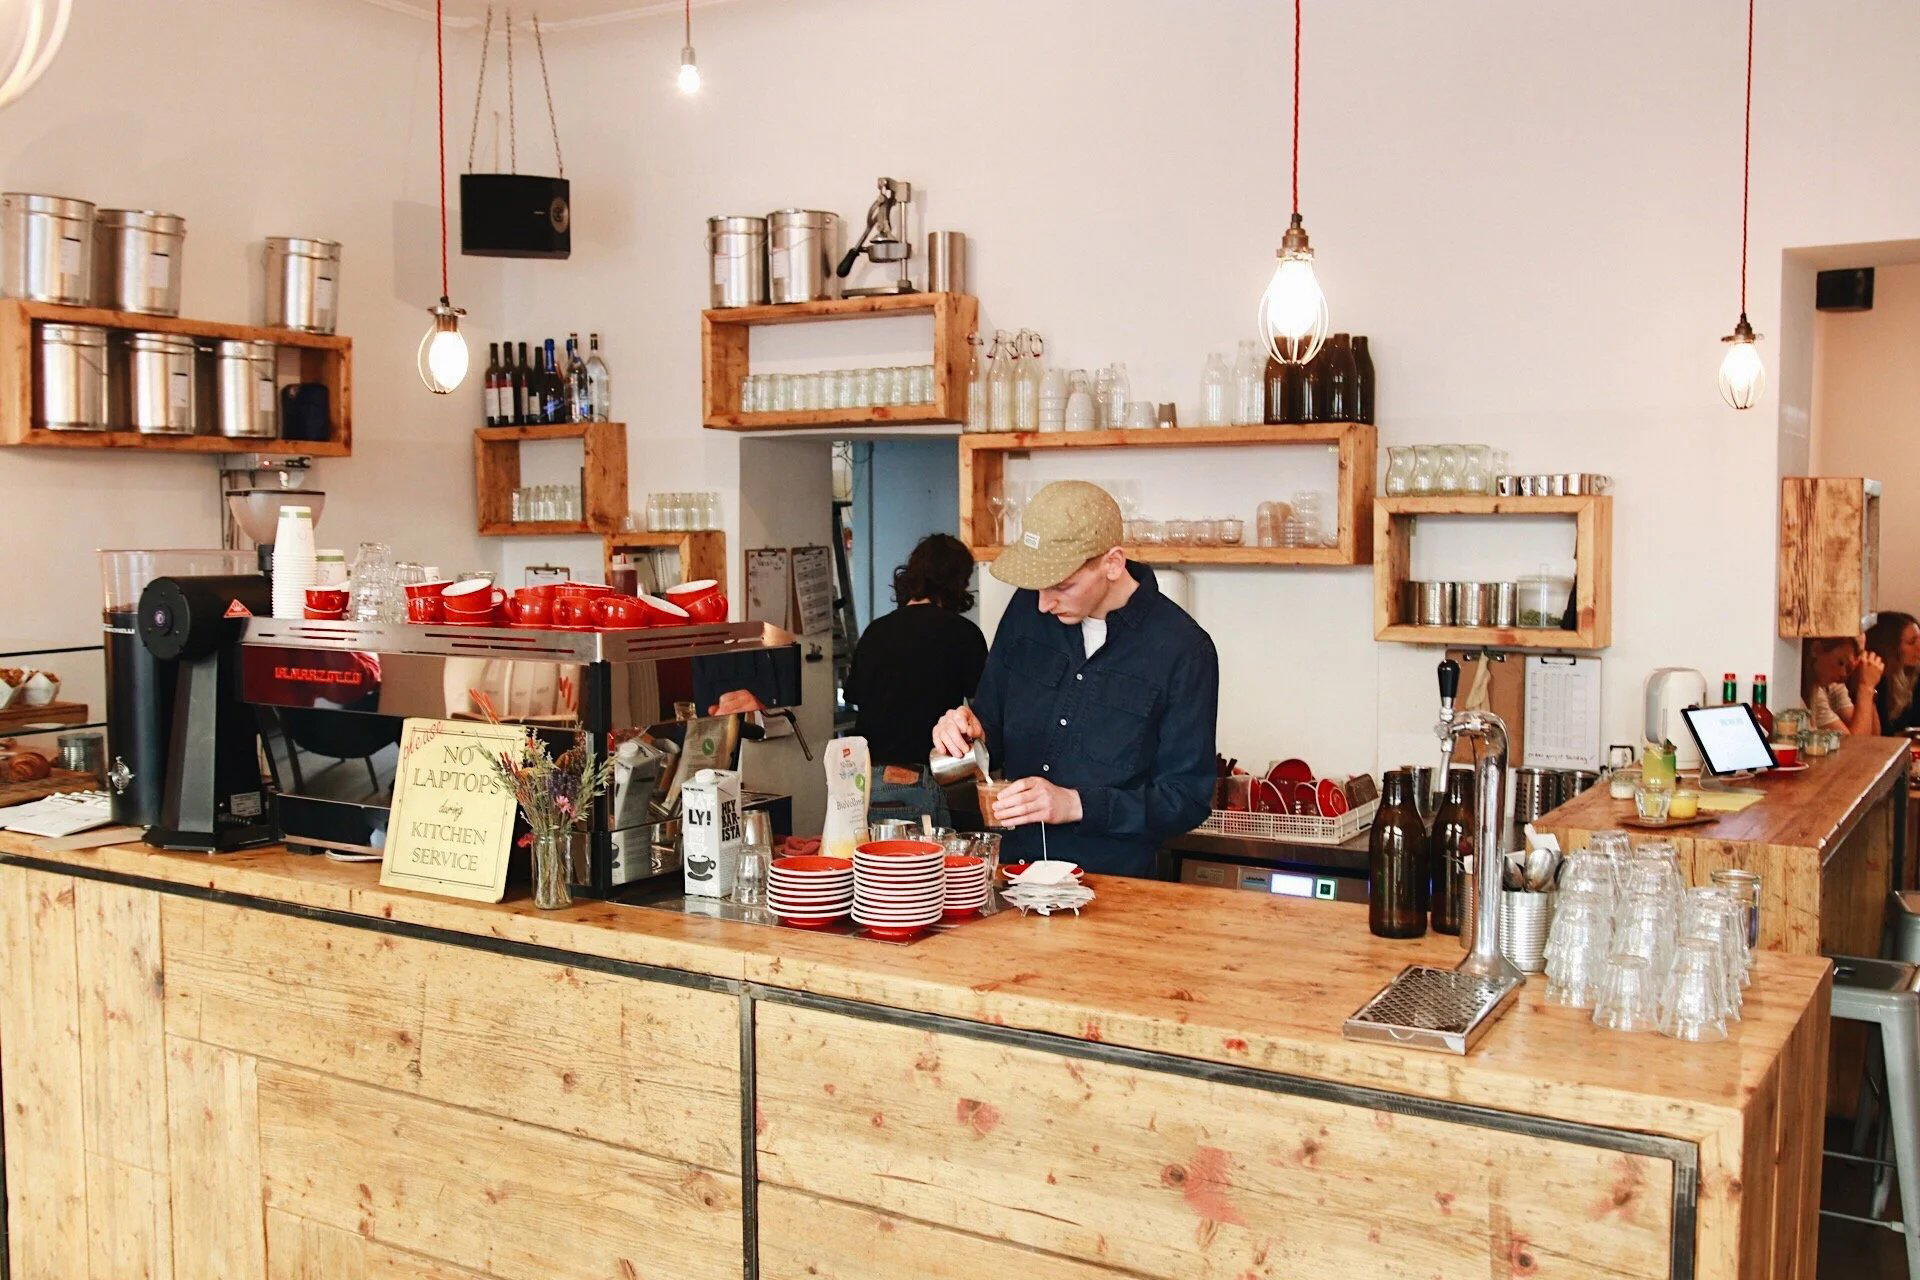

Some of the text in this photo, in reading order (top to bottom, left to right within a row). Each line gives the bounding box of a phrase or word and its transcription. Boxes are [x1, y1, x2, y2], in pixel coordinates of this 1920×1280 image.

[444, 745, 475, 766] NO
[412, 767, 501, 795] LAPTOPS
[438, 798, 464, 822] during
[688, 808, 712, 826] LY!
[721, 799, 736, 815] HEY
[721, 812, 740, 828] BAR-
[411, 821, 487, 846] KITCHEN
[721, 825, 741, 841] ISTA
[411, 847, 479, 872] SERVICE
